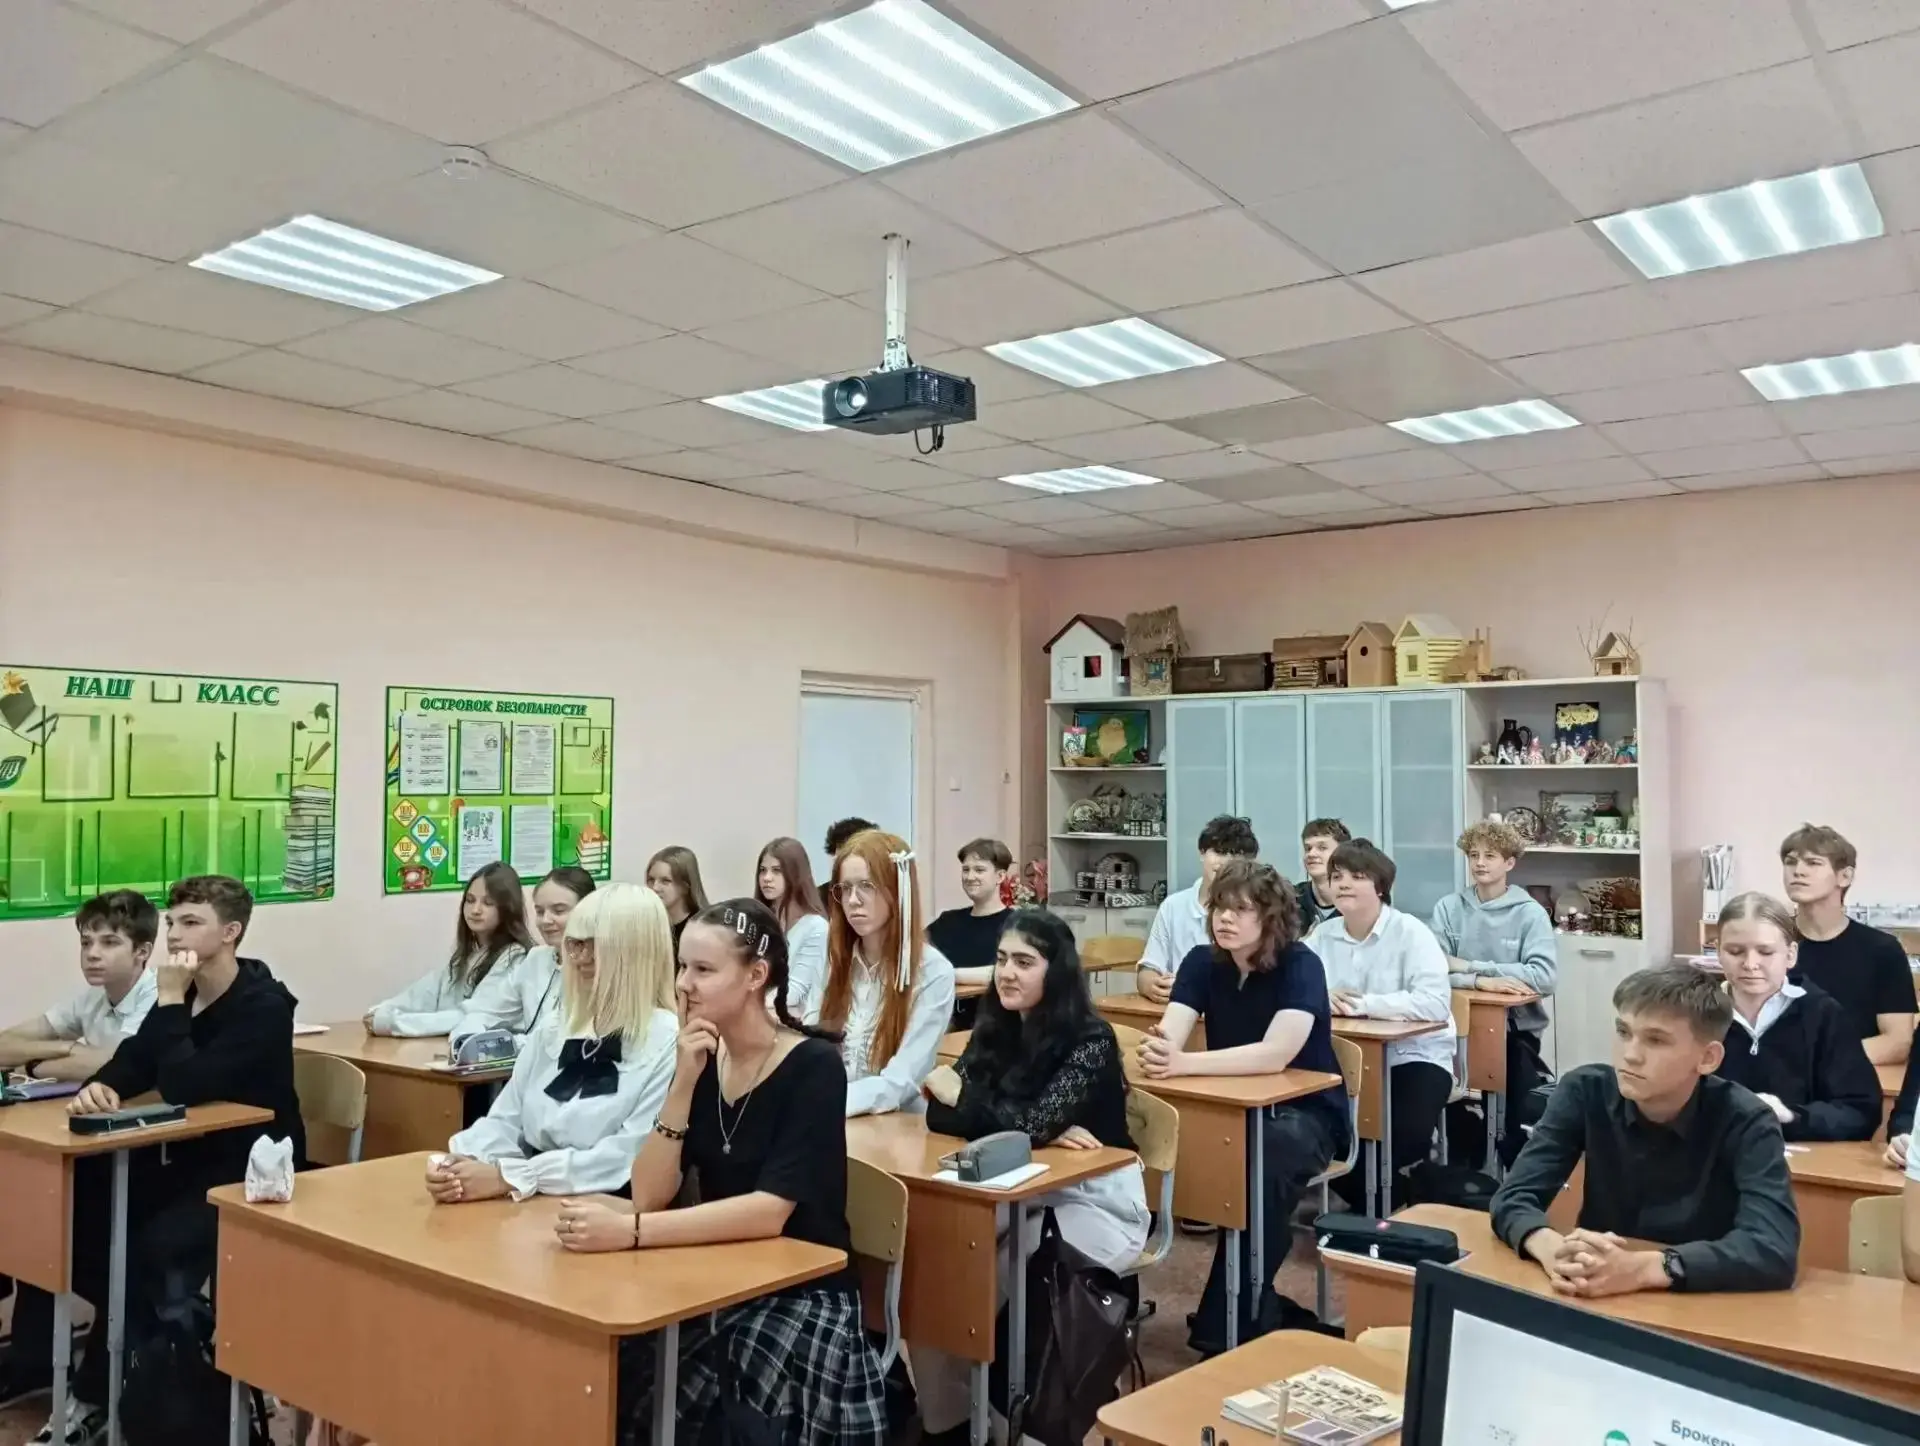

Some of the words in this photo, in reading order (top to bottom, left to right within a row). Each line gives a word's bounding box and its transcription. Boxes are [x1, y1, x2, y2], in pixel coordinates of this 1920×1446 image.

[66, 676, 135, 699] НАШ
[196, 682, 280, 705] КЛАСС
[420, 697, 493, 713] ОСТРОВОК
